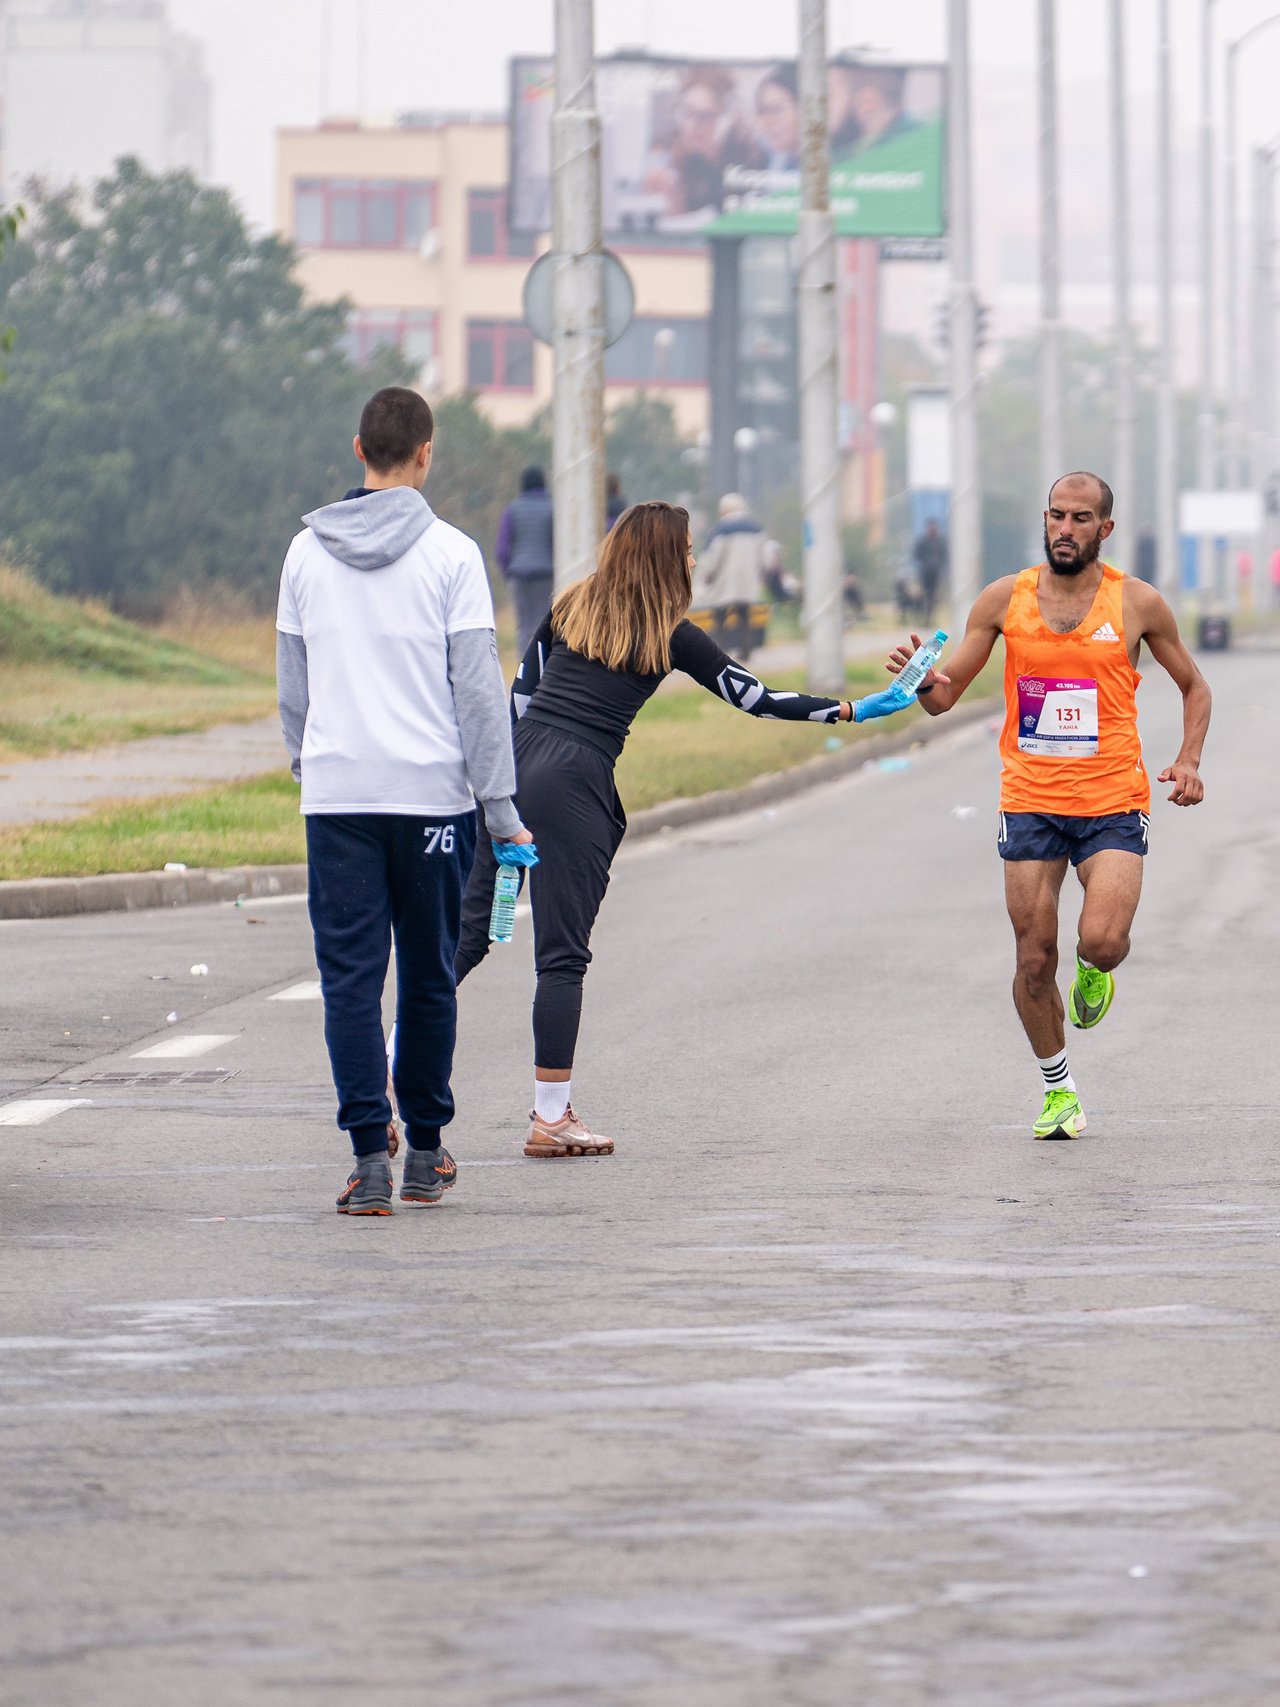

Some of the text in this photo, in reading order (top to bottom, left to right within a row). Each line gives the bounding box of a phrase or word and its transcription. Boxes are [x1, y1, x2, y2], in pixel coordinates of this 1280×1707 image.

[1091, 633, 1120, 642] adidas
[1056, 708, 1080, 721] 131
[424, 824, 455, 853] 76
